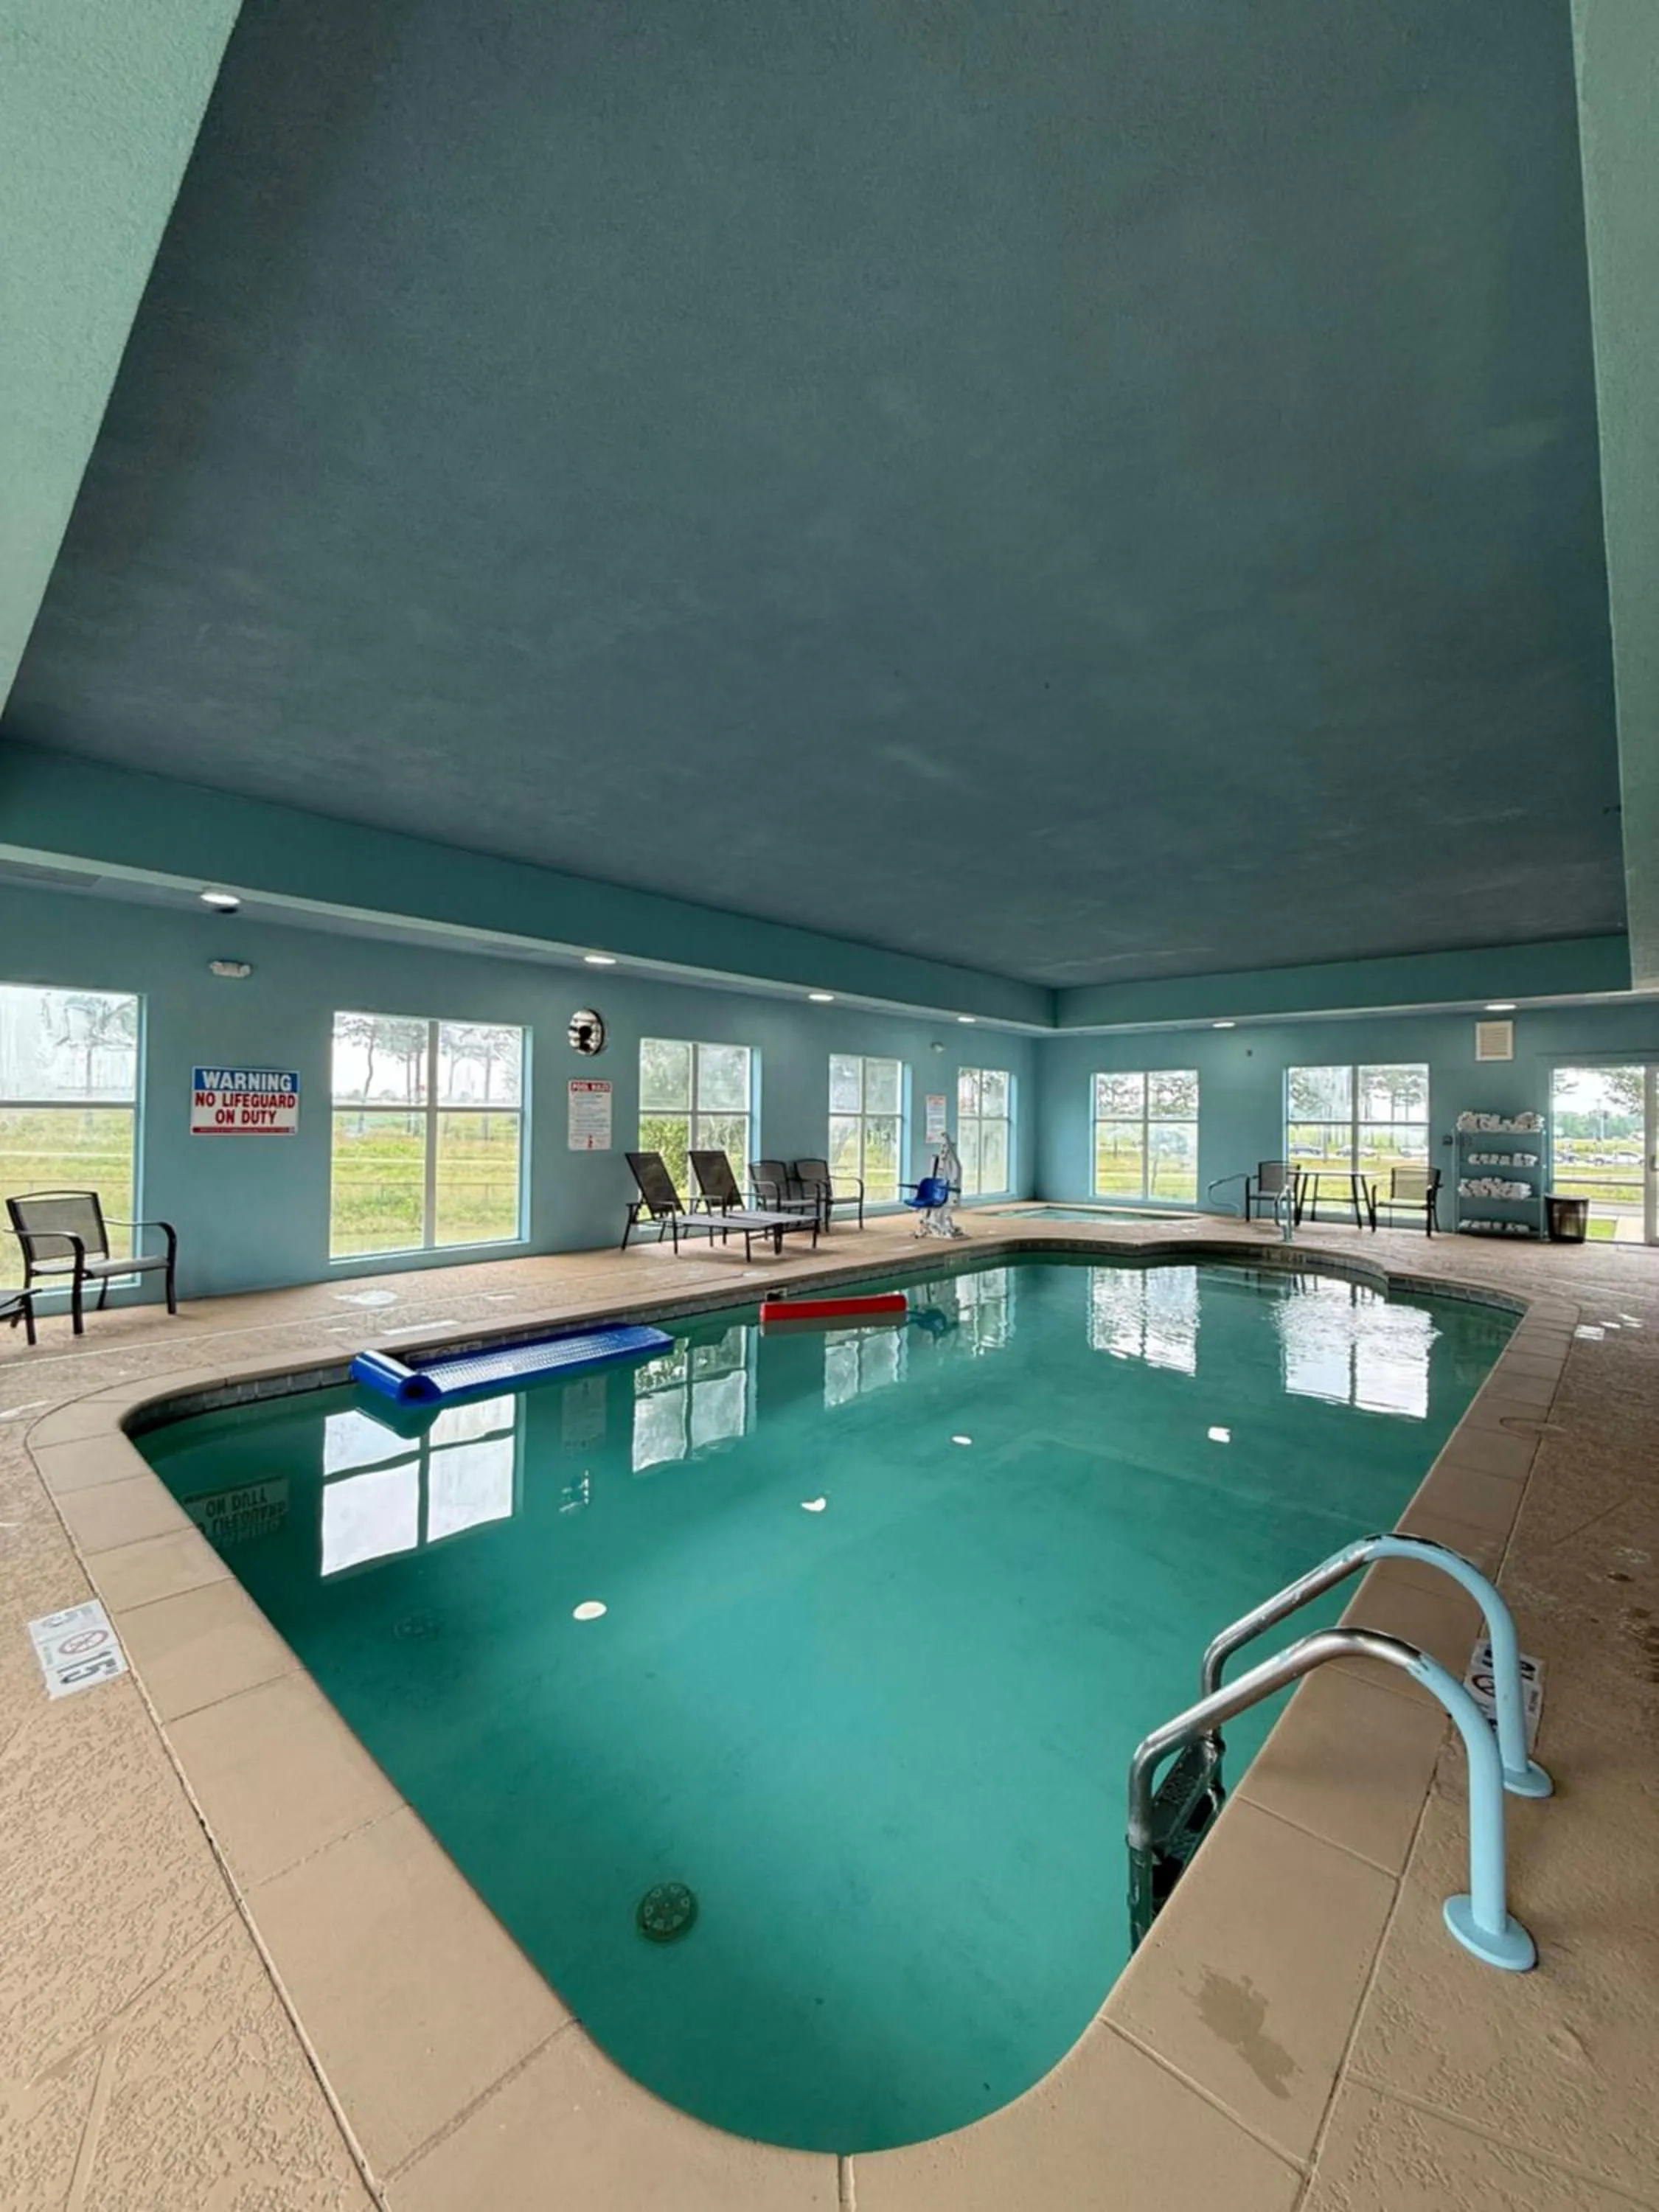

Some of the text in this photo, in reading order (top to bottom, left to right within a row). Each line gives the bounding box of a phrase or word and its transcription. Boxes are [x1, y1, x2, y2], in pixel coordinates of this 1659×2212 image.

[202, 1071, 292, 1091] WARNING
[195, 1092, 296, 1108] NO LIFEGUARD
[215, 1109, 276, 1125] ON DUTY
